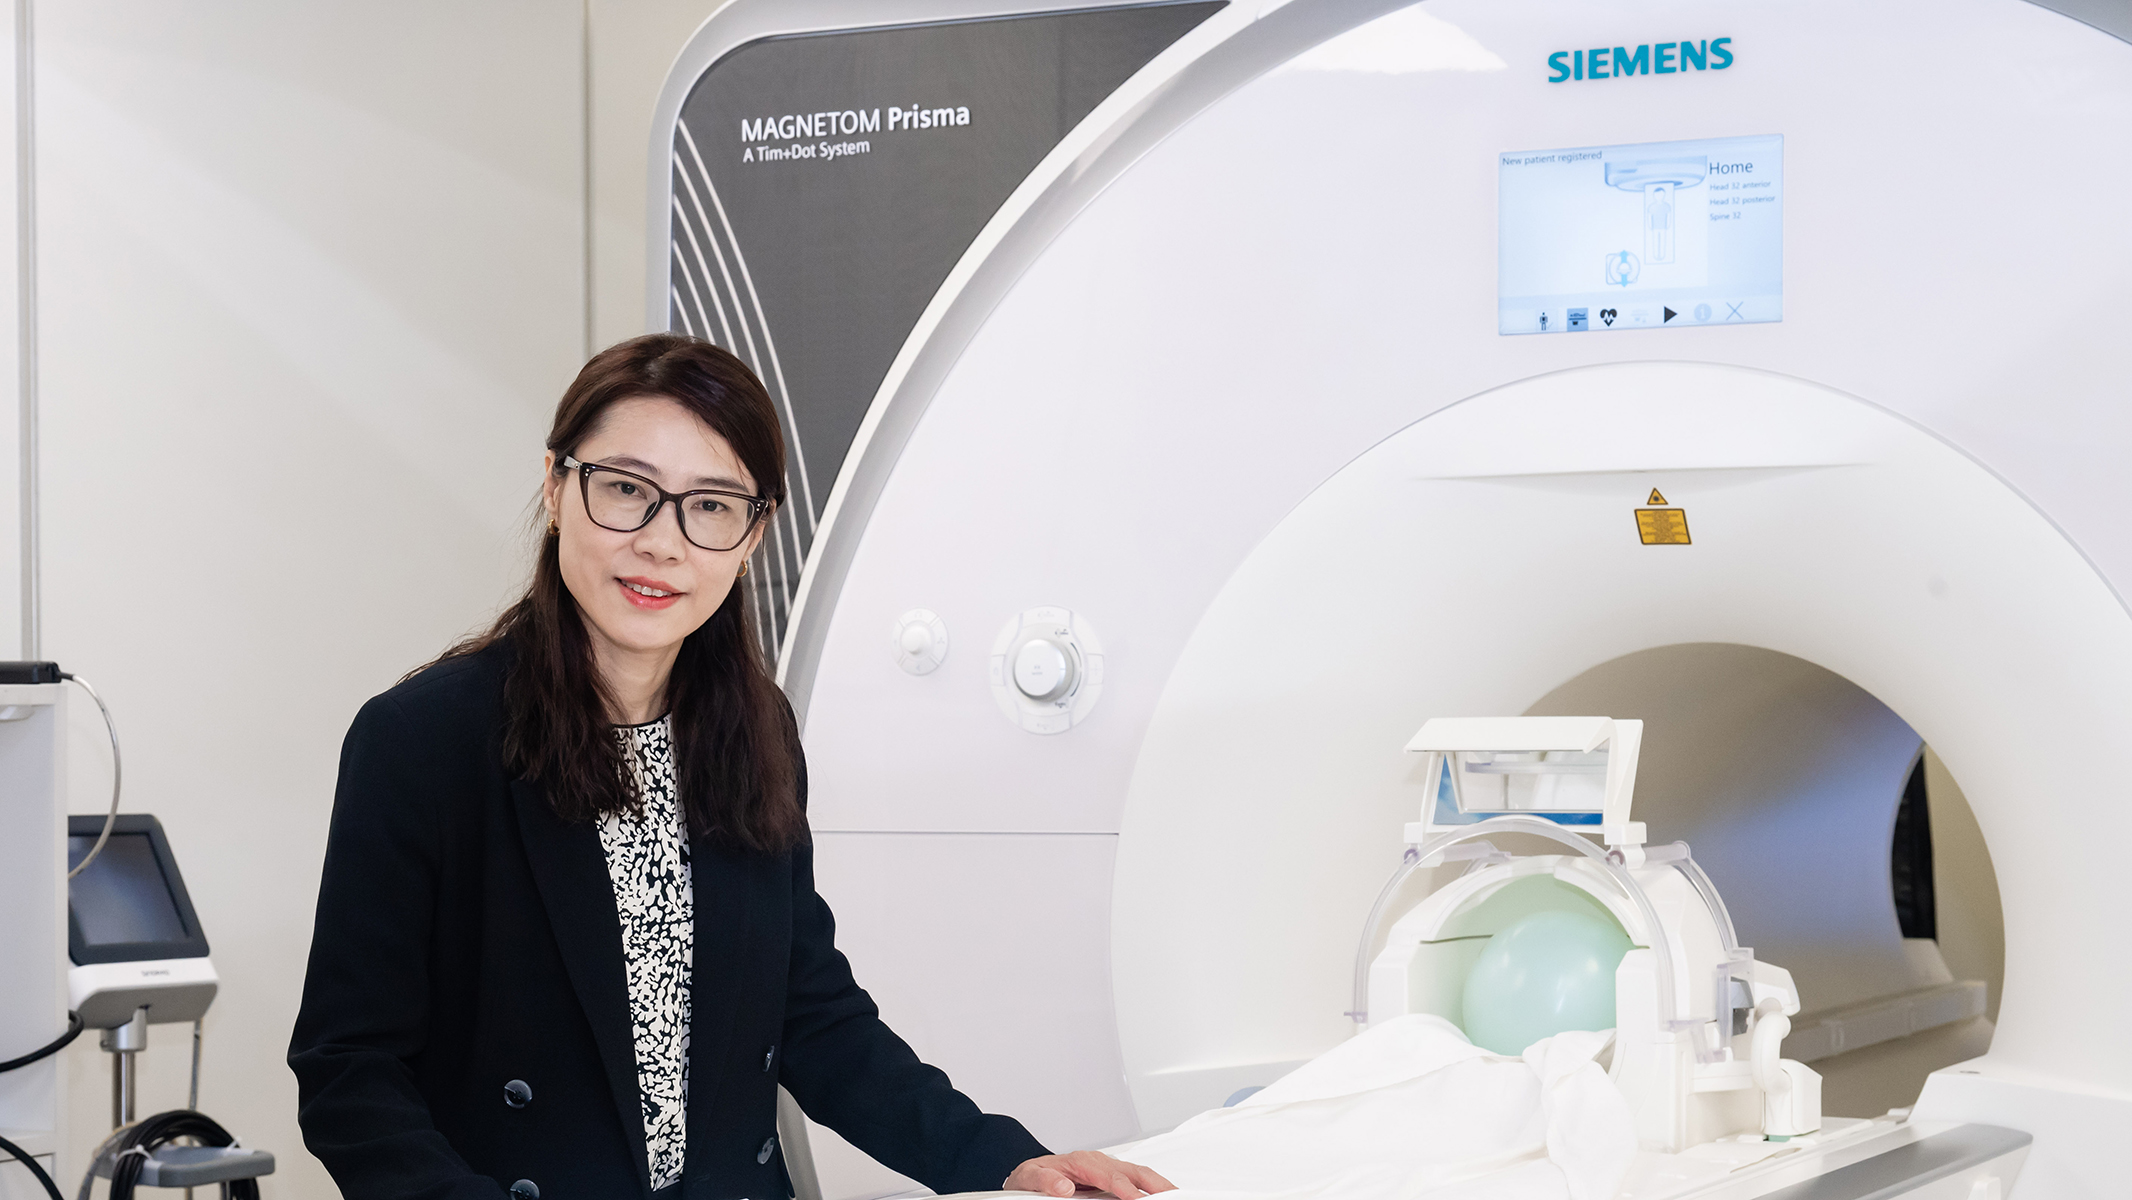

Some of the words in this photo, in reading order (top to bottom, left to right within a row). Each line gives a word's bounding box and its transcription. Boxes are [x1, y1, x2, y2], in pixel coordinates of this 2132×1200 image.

[1547, 37, 1734, 83] SIEMENS
[741, 108, 881, 142] MAGNETOM
[888, 103, 971, 131] Prisma
[742, 147, 754, 163] A
[756, 143, 817, 162] Tim+Dot
[819, 140, 871, 161] System
[1502, 156, 1522, 166] New
[1524, 154, 1556, 167] patient
[1557, 150, 1603, 164] registered
[1709, 161, 1754, 175] Home
[1709, 183, 1730, 191] Head
[1731, 181, 1741, 190] 32
[1742, 180, 1772, 189] anterior
[1709, 197, 1730, 206] Head
[1731, 196, 1741, 205] 32
[1742, 194, 1776, 206] posterior
[1709, 212, 1730, 222] Spine
[1732, 211, 1742, 220] 32
